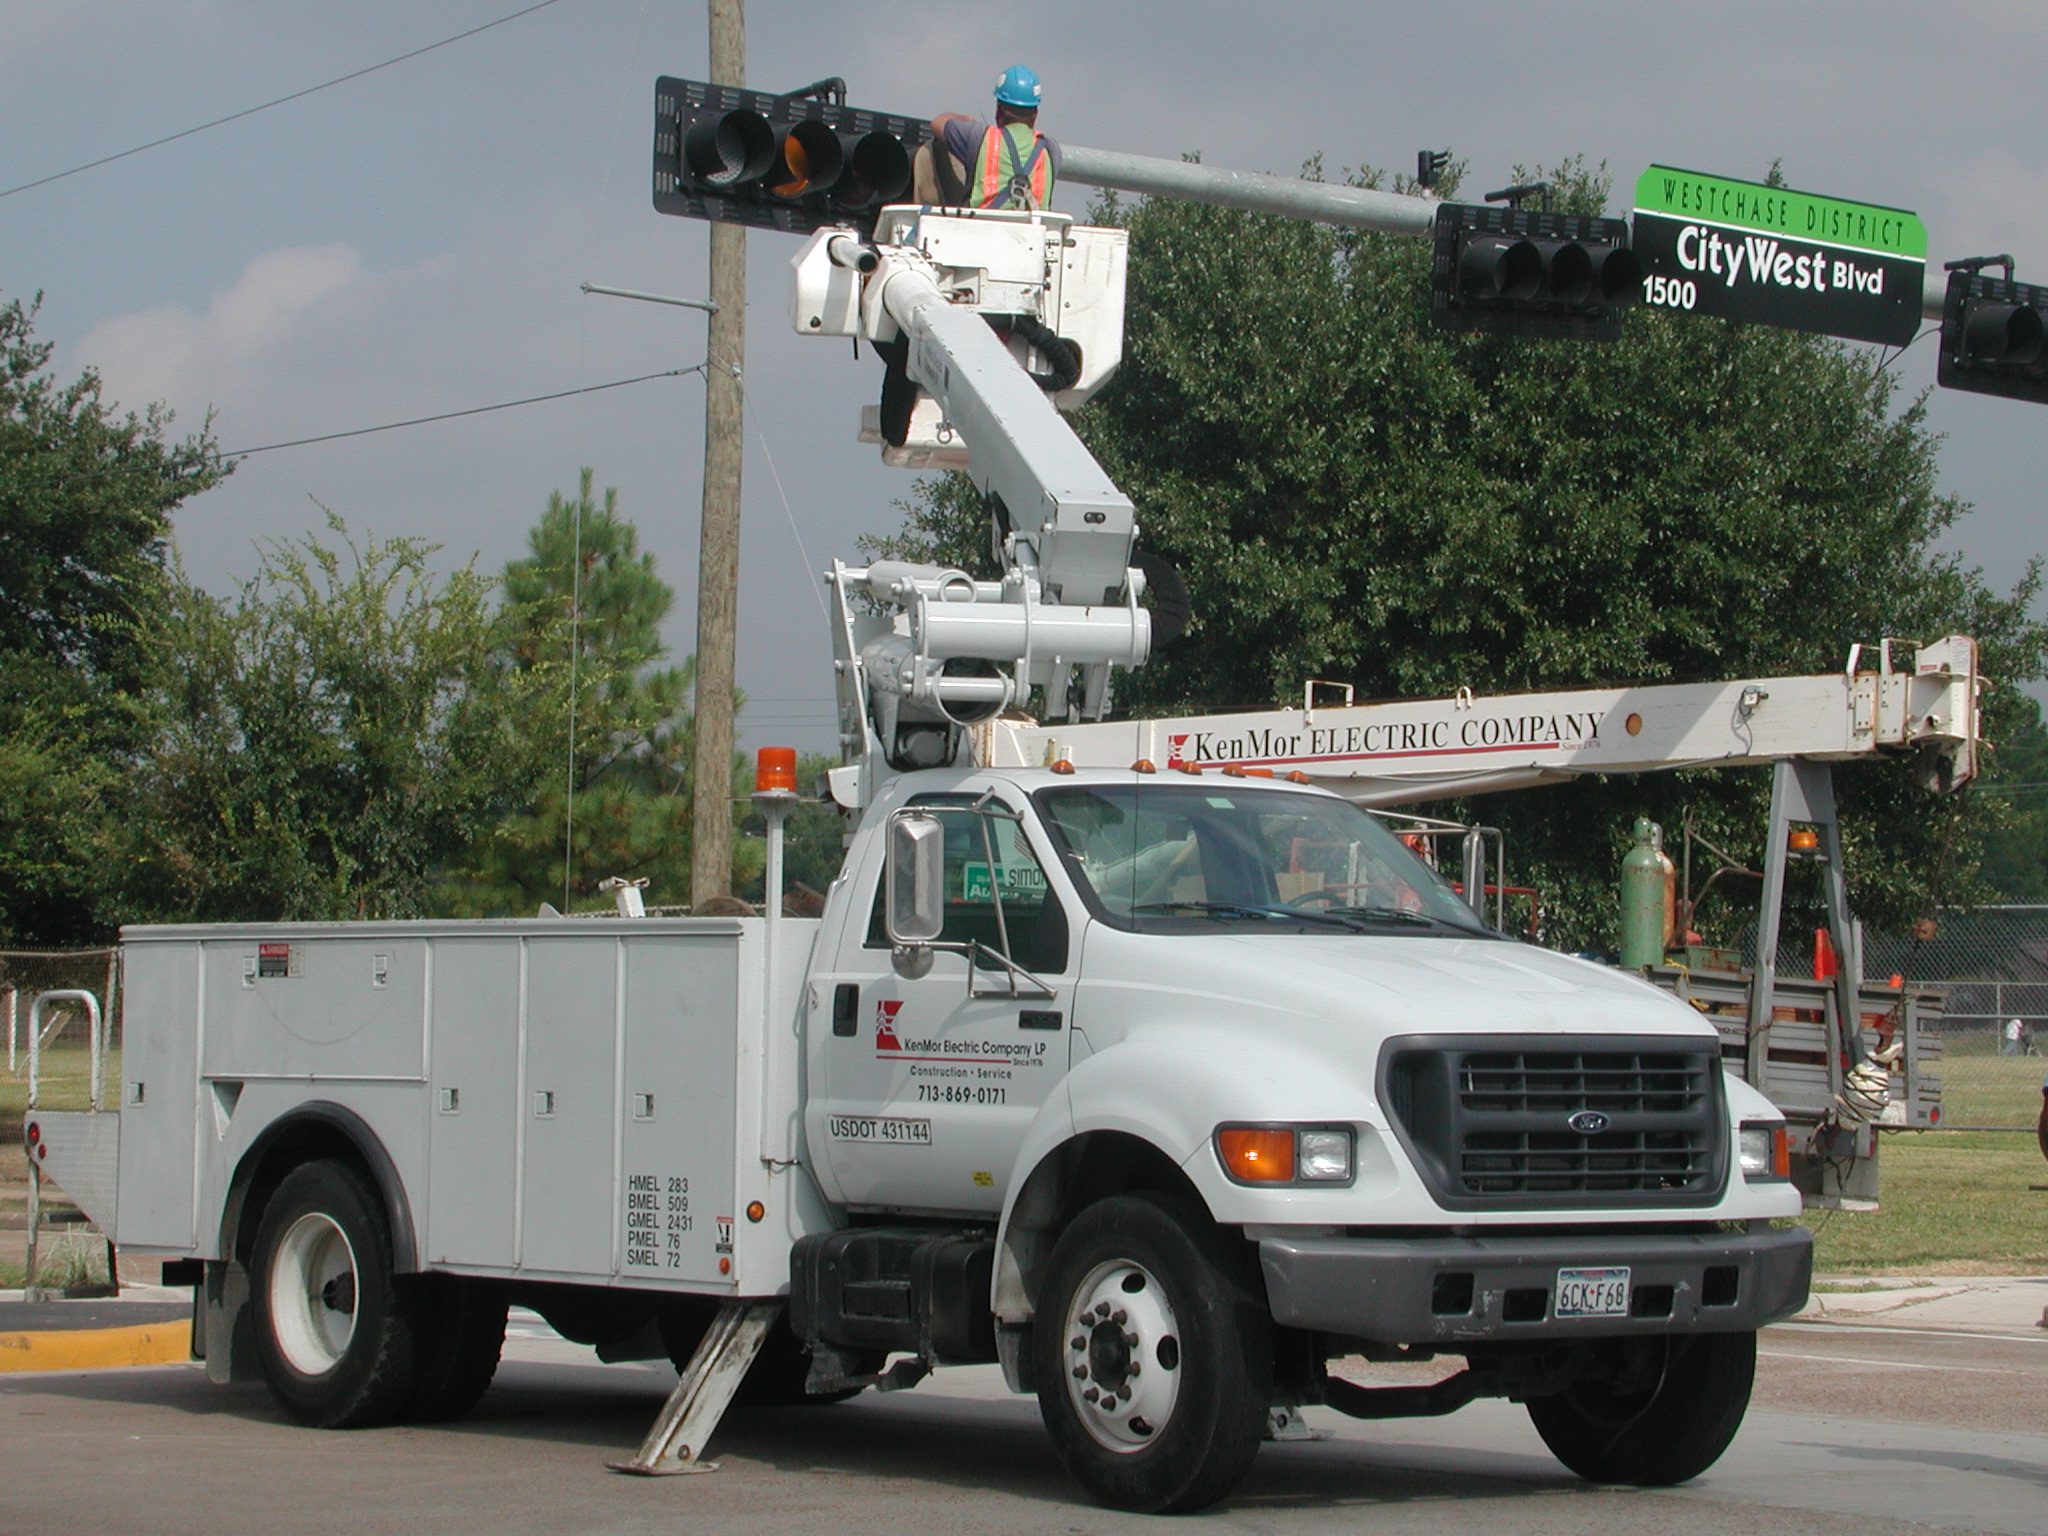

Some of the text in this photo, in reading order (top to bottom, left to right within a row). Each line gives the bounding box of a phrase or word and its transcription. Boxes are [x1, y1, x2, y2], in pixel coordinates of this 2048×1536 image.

[1663, 178, 1904, 248] WESTCHASE DISTRICT
[1676, 225, 1884, 295] CityWest Blvd
[1642, 274, 1697, 310] 1500
[1194, 711, 1605, 762] KenMor ELECTRIC COMPANY
[904, 1038, 1046, 1057] KenMor Electric Company LP
[910, 1065, 1012, 1080] Construction Service
[830, 1119, 929, 1141] USDOT 431144
[627, 1175, 689, 1193] HMEL 283
[627, 1193, 688, 1212] BMEL 509
[627, 1211, 693, 1231] GMEL 2431
[627, 1231, 680, 1249] PMEL 76
[627, 1249, 680, 1268] SMEL 72
